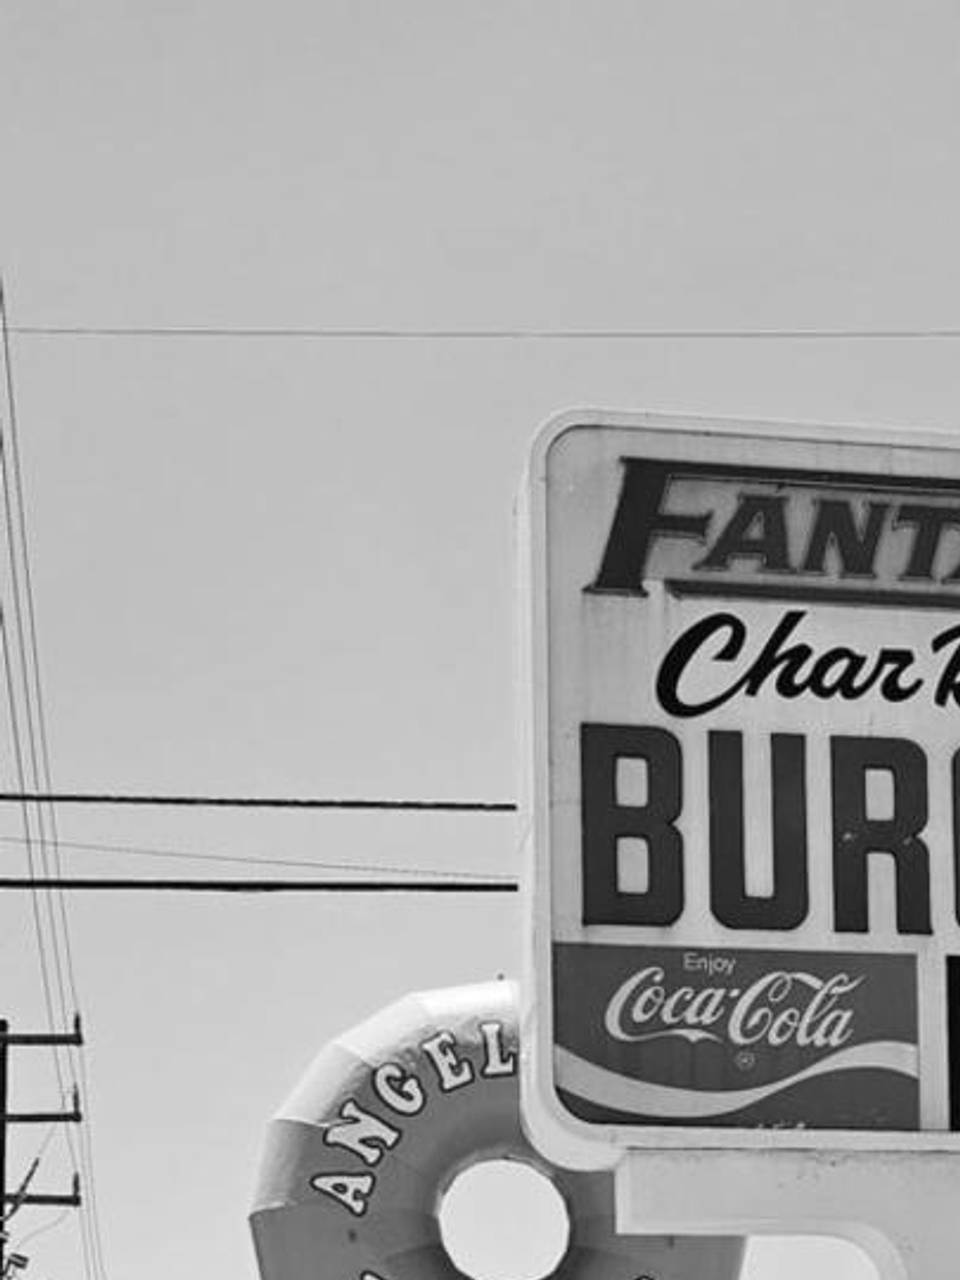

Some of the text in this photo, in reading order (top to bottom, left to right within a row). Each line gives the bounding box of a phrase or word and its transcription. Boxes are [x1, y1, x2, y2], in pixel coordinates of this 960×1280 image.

[654, 610, 924, 719] Char
[604, 966, 867, 1048] Coca-Cola
[683, 952, 736, 975] Enjoy
[312, 1021, 518, 1216] ANGEL
